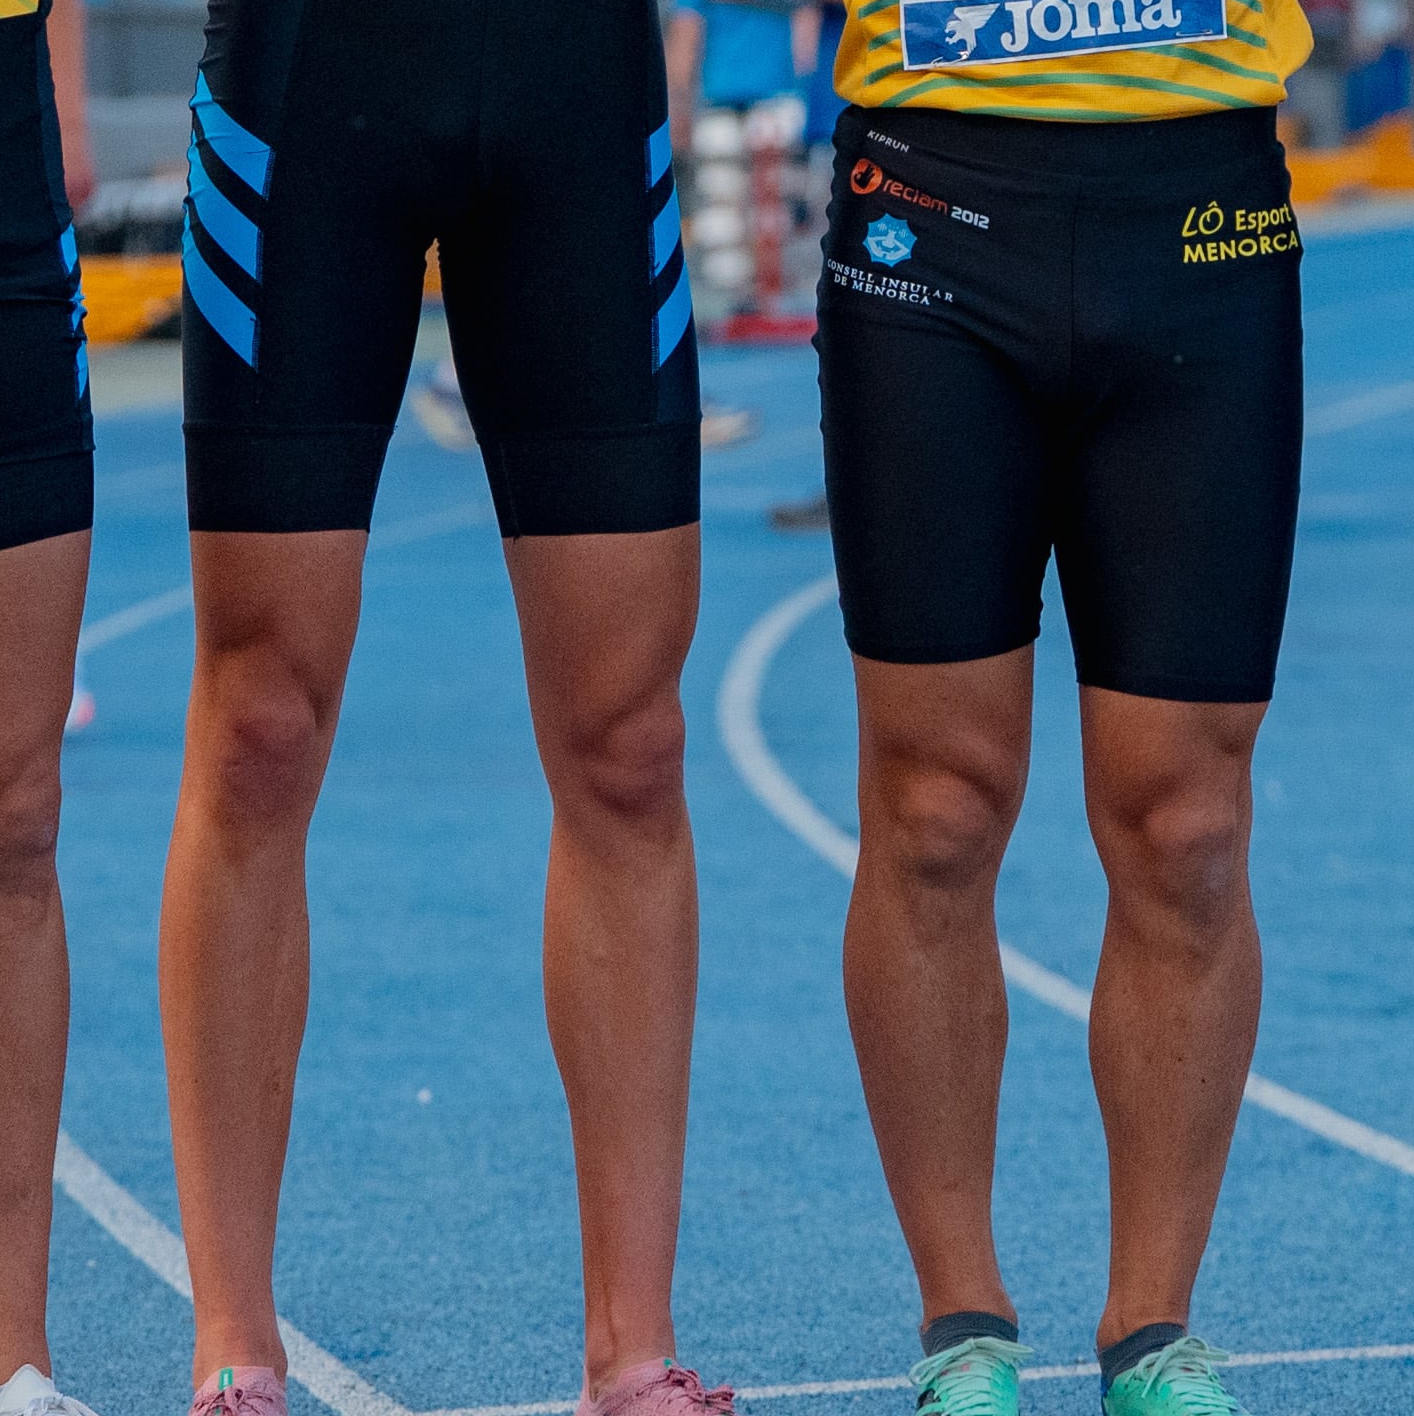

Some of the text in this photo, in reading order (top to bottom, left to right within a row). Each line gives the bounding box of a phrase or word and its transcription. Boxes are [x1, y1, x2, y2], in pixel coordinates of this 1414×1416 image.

[867, 129, 910, 153] KIPRUN
[950, 205, 990, 230] 2012
[1235, 203, 1292, 234] Esport
[1183, 230, 1299, 263] MENORCA
[827, 258, 954, 303] CONSELL INSULAR
[834, 273, 931, 306] DE MENORCA
